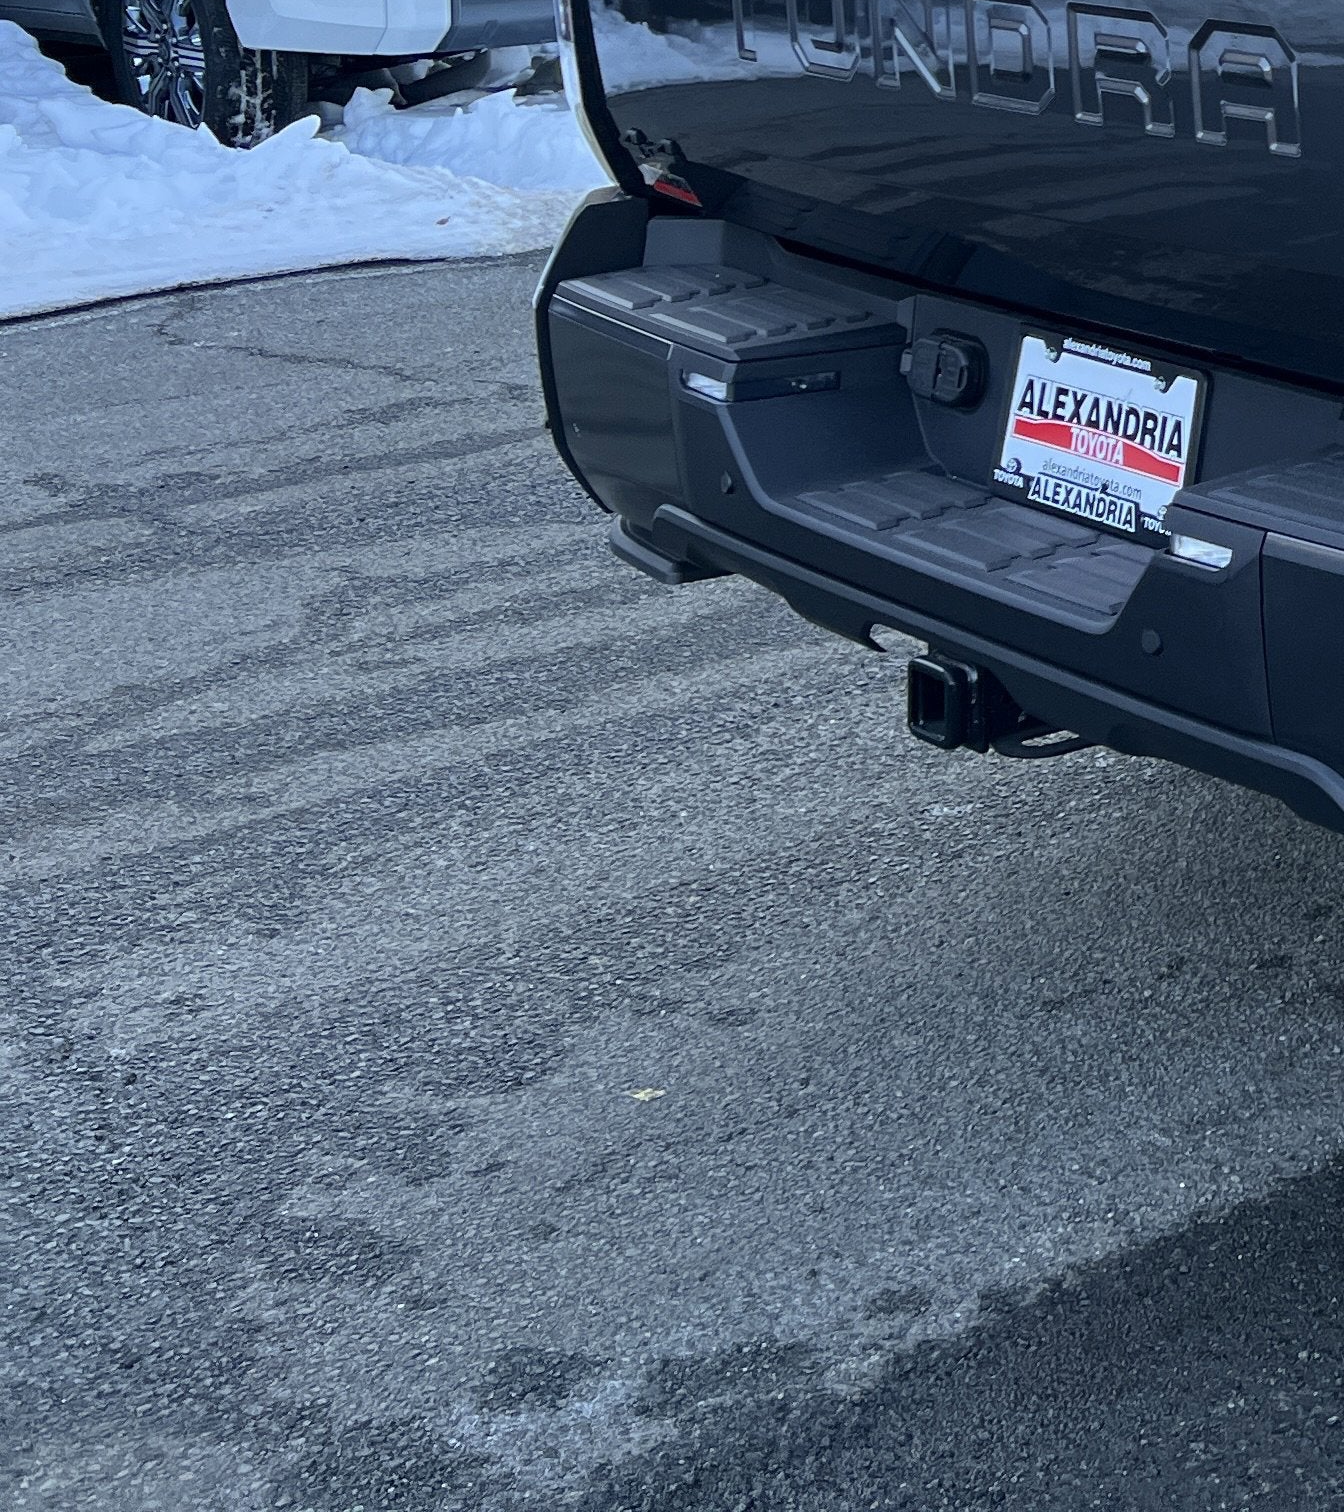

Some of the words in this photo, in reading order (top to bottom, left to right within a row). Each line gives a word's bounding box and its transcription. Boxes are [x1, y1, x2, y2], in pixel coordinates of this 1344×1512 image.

[1017, 379, 1182, 458] ALEXANDRIA
[1071, 426, 1124, 466] TOYOTA
[993, 469, 1024, 488] TOYOTA
[1031, 477, 1134, 530] ALEXANDRIA
